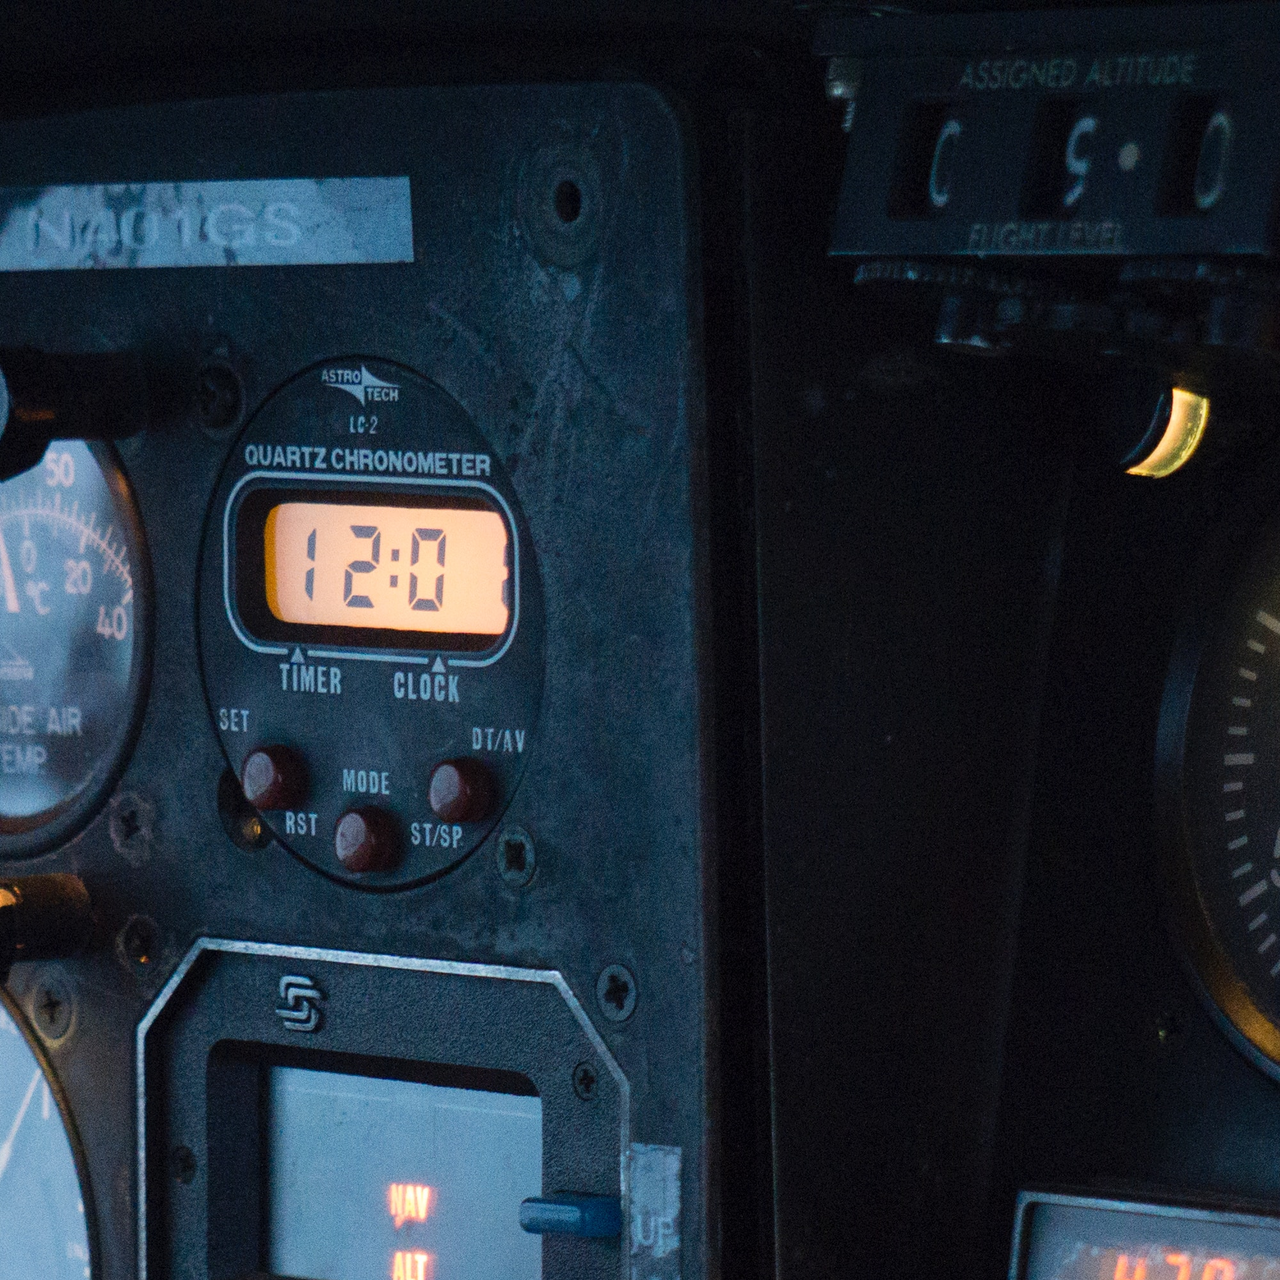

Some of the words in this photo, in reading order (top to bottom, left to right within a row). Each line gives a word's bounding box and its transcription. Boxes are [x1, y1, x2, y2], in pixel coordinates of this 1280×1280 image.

[959, 58, 1077, 90] ASSIGNED
[1085, 53, 1197, 86] ALTITUDE
[28, 199, 305, 252] N401GS
[321, 369, 361, 385] ASTRO
[365, 387, 399, 402] TECH
[349, 415, 378, 434] LC-2
[244, 444, 327, 469] QUARTZ
[330, 449, 491, 477] CHRONOMETER
[279, 663, 342, 695] TIMER
[393, 671, 460, 703] CLOCK
[45, 706, 84, 737] AIR
[220, 708, 250, 733] SET
[471, 727, 526, 754] DT/AV
[342, 769, 391, 795] MODE
[285, 810, 318, 837] RST
[410, 822, 463, 850] ST/SP
[389, 1182, 431, 1222] NAV
